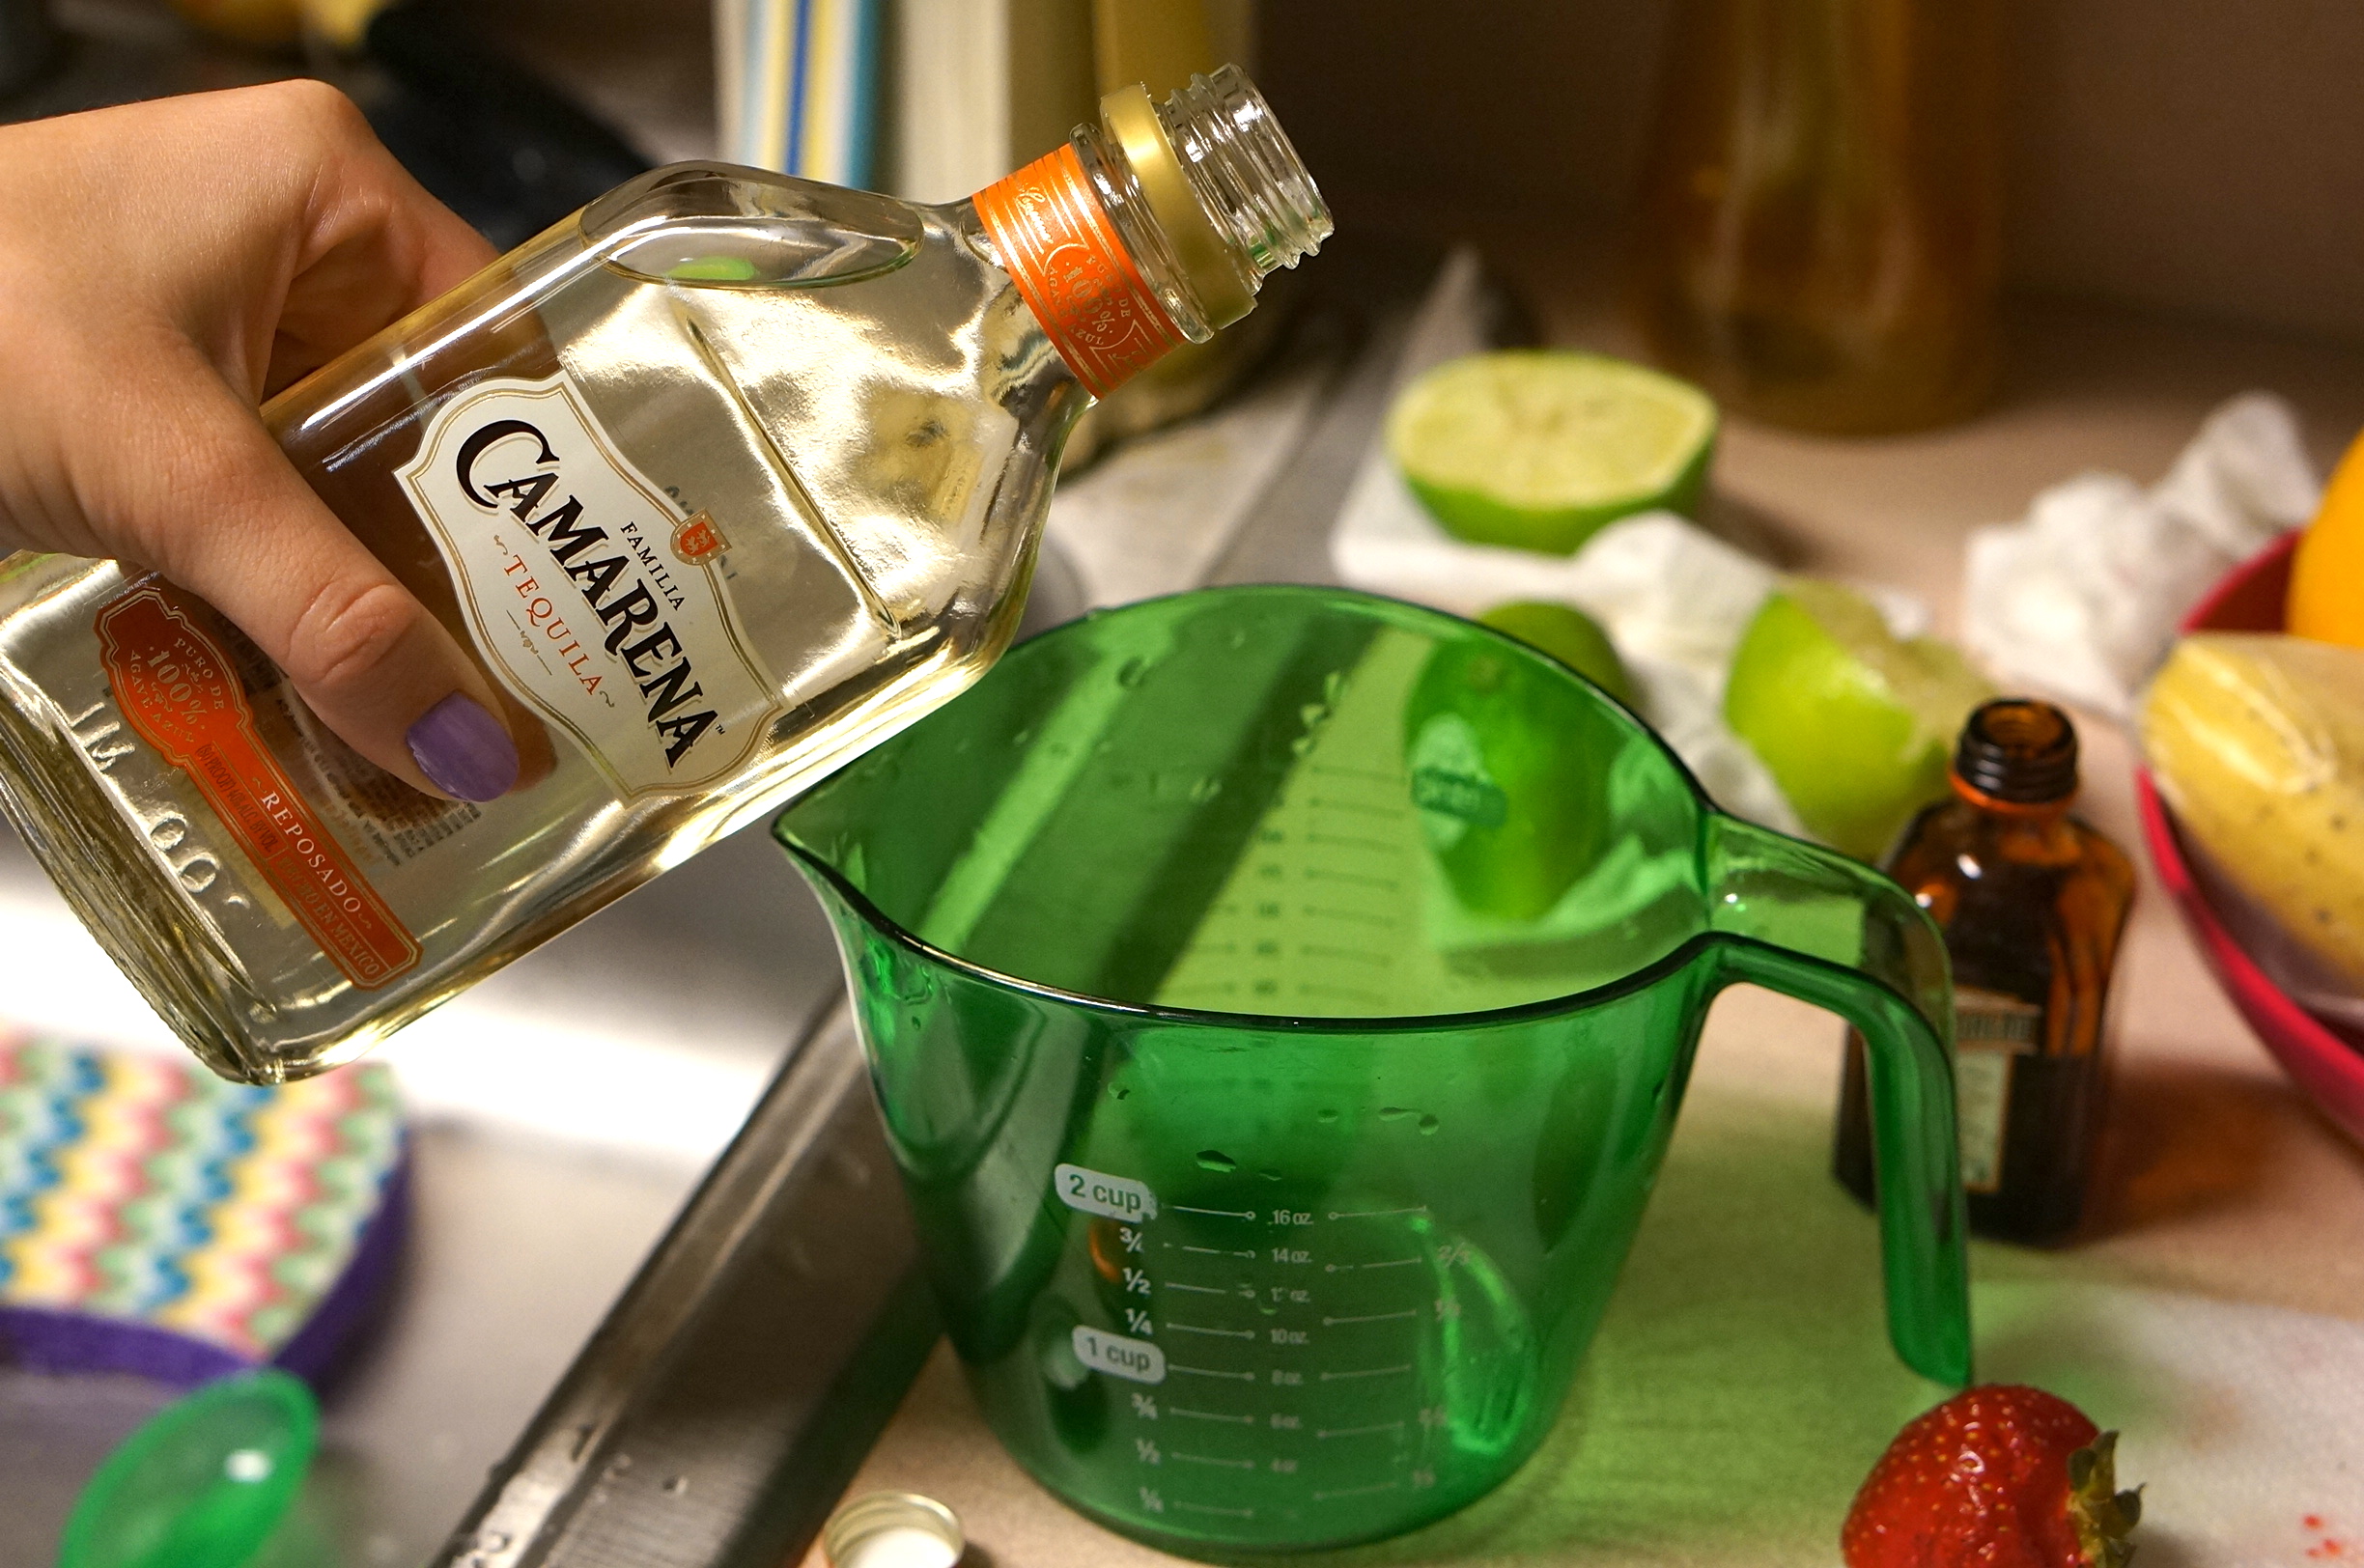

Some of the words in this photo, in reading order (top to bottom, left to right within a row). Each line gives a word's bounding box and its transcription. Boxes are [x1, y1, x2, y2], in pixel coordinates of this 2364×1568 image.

[1062, 266, 1115, 332] 100%
[1118, 297, 1131, 318] DE
[456, 419, 718, 769] CAMARENA
[620, 521, 686, 611] FAMILIA
[503, 553, 604, 696] TEQUILA
[129, 650, 154, 709] AGAVE
[153, 713, 194, 742] AZUL
[148, 650, 207, 725] 100%
[174, 637, 213, 679] PURO
[210, 685, 224, 710] DE
[260, 790, 361, 912] REPOSADO
[312, 902, 339, 925] EN
[330, 922, 380, 975] MEXICO
[1069, 1173, 1086, 1199] 2
[1092, 1184, 1142, 1215] cup
[1272, 1209, 1291, 1226] 16
[1122, 1267, 1152, 1296] 1/2
[1271, 1247, 1289, 1264] 14
[1124, 1307, 1154, 1335] 1/4
[1270, 1329, 1289, 1344] 10
[1087, 1336, 1099, 1357] 1
[1106, 1344, 1152, 1374] cup
